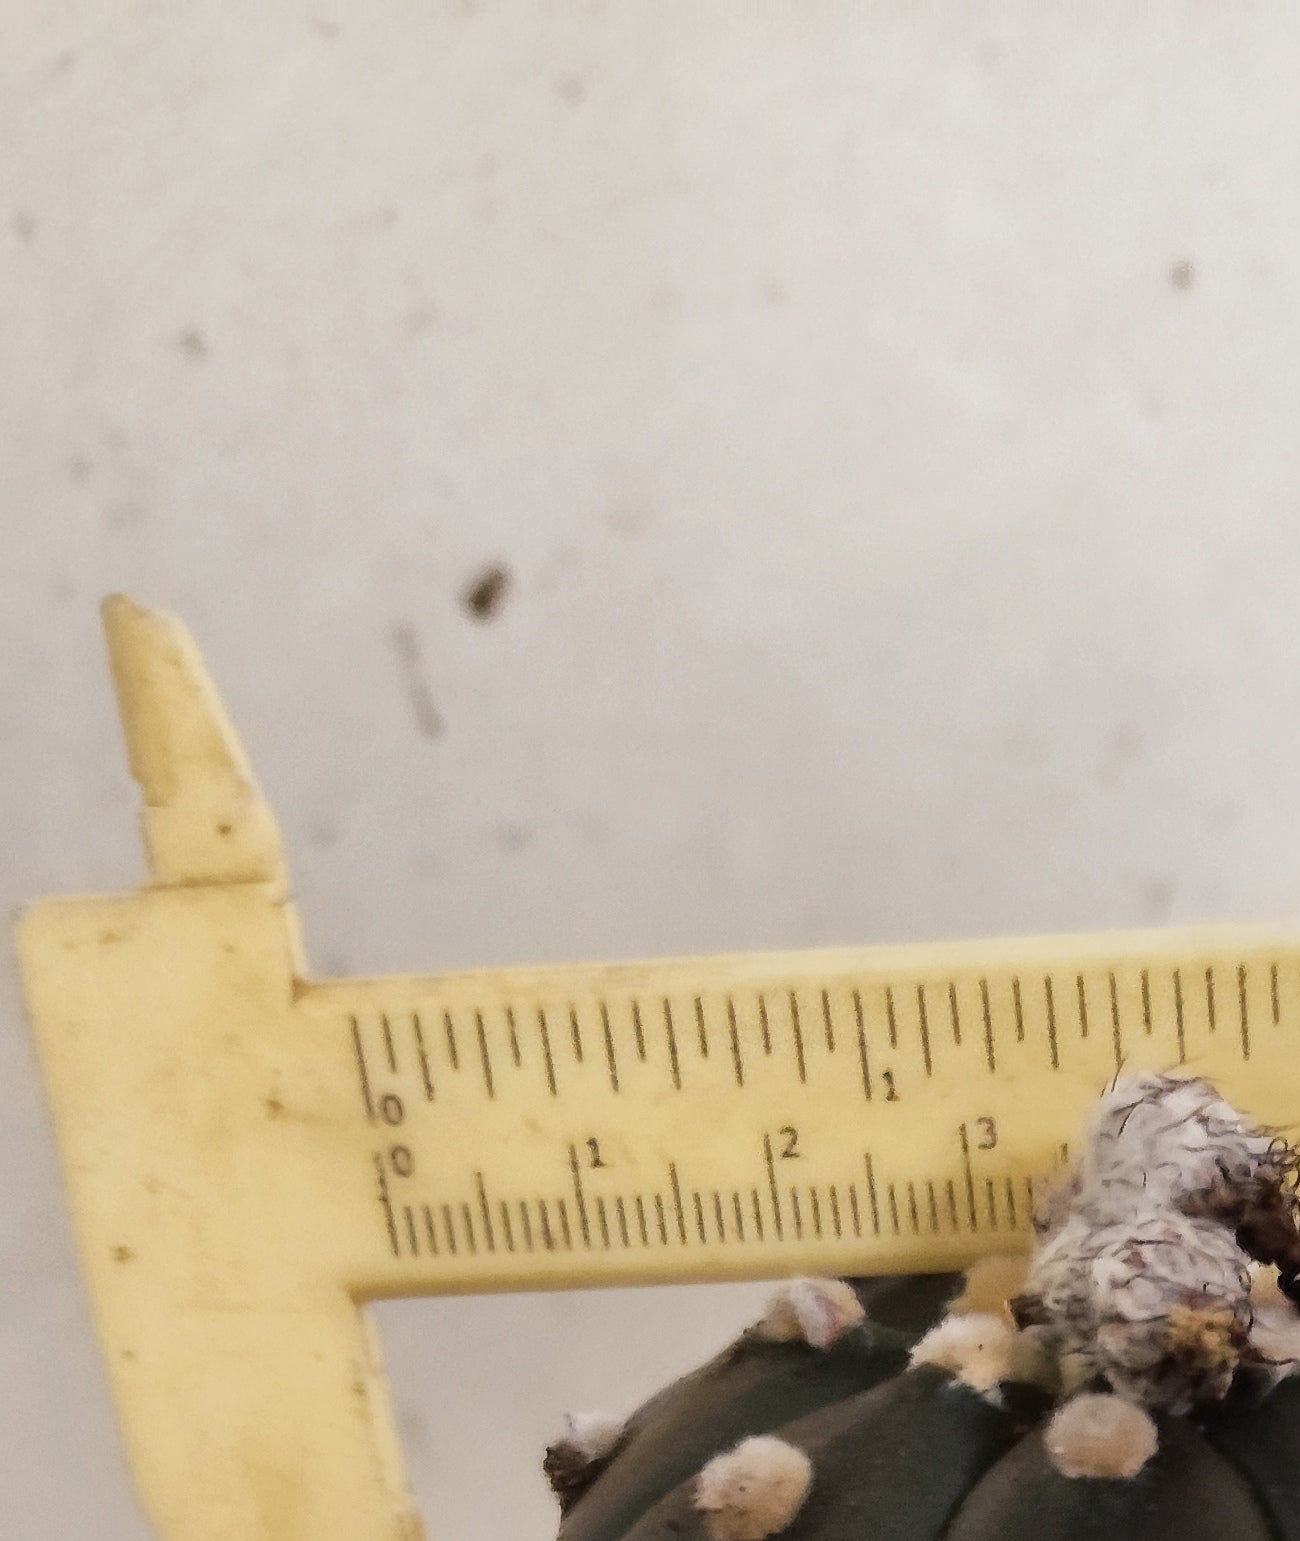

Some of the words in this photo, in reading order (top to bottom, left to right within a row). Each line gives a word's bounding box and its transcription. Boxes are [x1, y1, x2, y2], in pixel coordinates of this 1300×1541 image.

[382, 1094, 404, 1126] 0
[882, 1069, 899, 1102] 1
[391, 1145, 413, 1178] 0
[586, 1136, 606, 1169] 1
[779, 1126, 801, 1159] 2
[976, 1116, 998, 1150] 3
